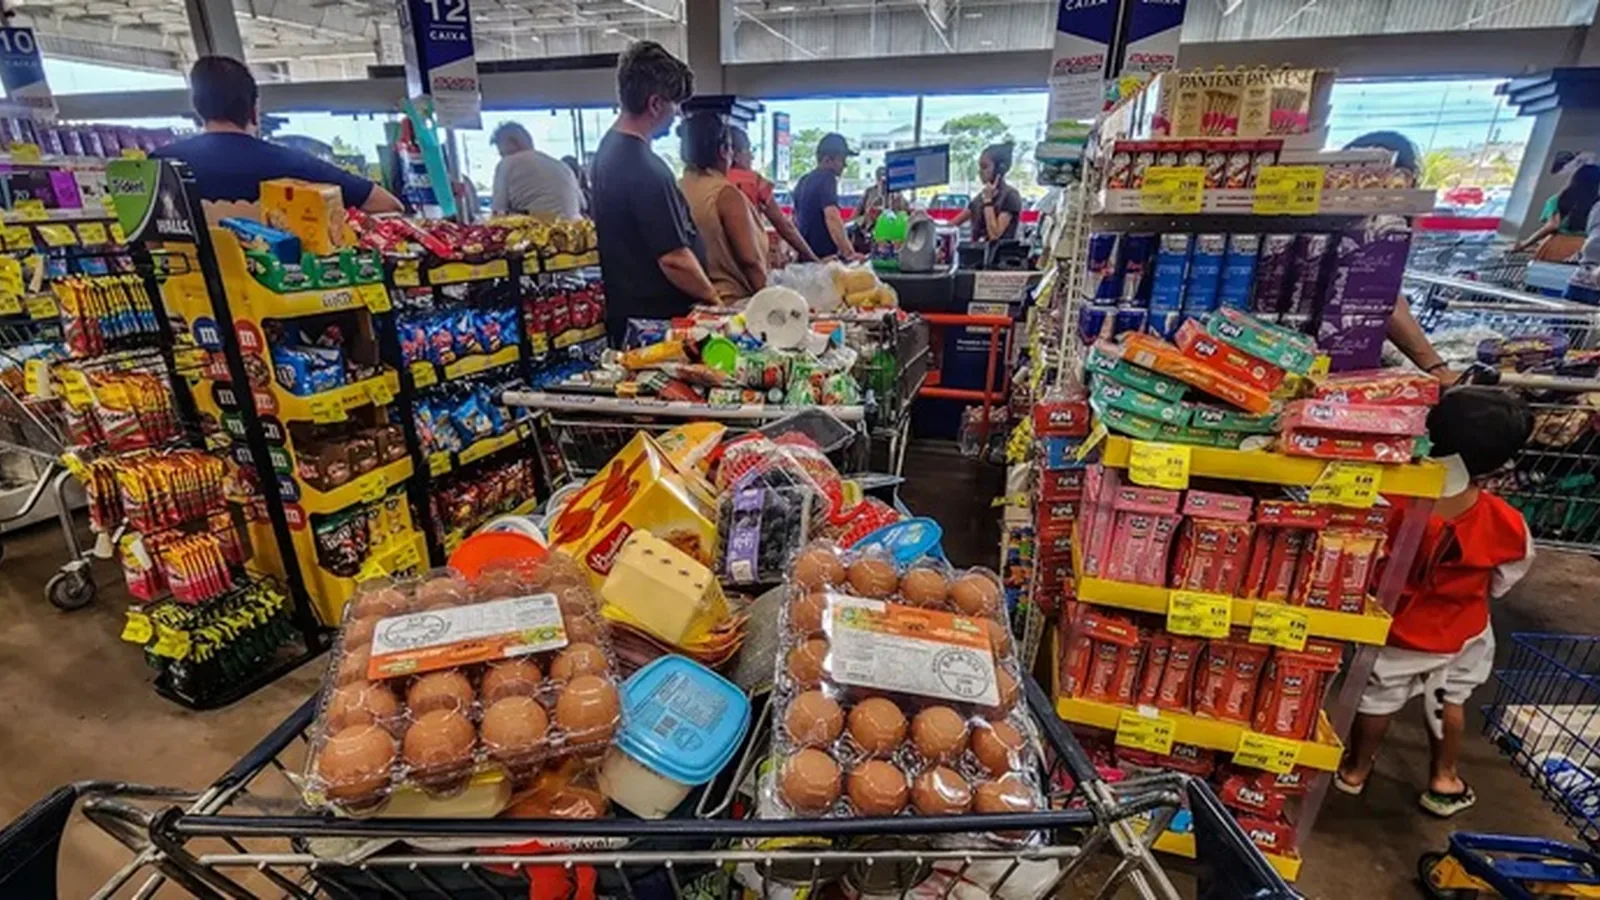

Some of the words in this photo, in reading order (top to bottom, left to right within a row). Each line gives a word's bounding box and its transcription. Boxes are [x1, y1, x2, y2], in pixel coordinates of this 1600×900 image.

[425, 0, 467, 21] 12
[0, 30, 34, 53] 10
[429, 30, 467, 40] CAIXA
[1179, 75, 1243, 88] PANTENE
[1246, 71, 1310, 86] PANTENE
[113, 178, 145, 194] Trident
[156, 219, 192, 235] HALLS
[200, 327, 219, 343] m
[1219, 323, 1243, 338] Fini
[239, 330, 257, 346] m
[1195, 341, 1218, 355] Fini
[1097, 356, 1118, 370] Fini
[218, 389, 236, 405] m
[1103, 384, 1125, 399] Fini
[1051, 412, 1074, 424] Fini
[1201, 410, 1225, 422] Fini
[1310, 405, 1335, 419] Fini
[227, 420, 245, 434] m
[1295, 435, 1321, 448] Fini
[270, 452, 287, 467] m
[1058, 475, 1079, 487] Fini
[1122, 491, 1137, 500] Fini
[285, 508, 300, 523] m
[1051, 504, 1073, 515] Fini
[1264, 507, 1280, 515] Fini
[1131, 518, 1148, 529] Fini
[1201, 531, 1219, 542] Fini
[1283, 676, 1303, 685] Fini
[1176, 745, 1198, 758] Fini
[1277, 772, 1301, 784] Fini
[1240, 787, 1265, 802] Fini
[1250, 830, 1276, 844] Fini
